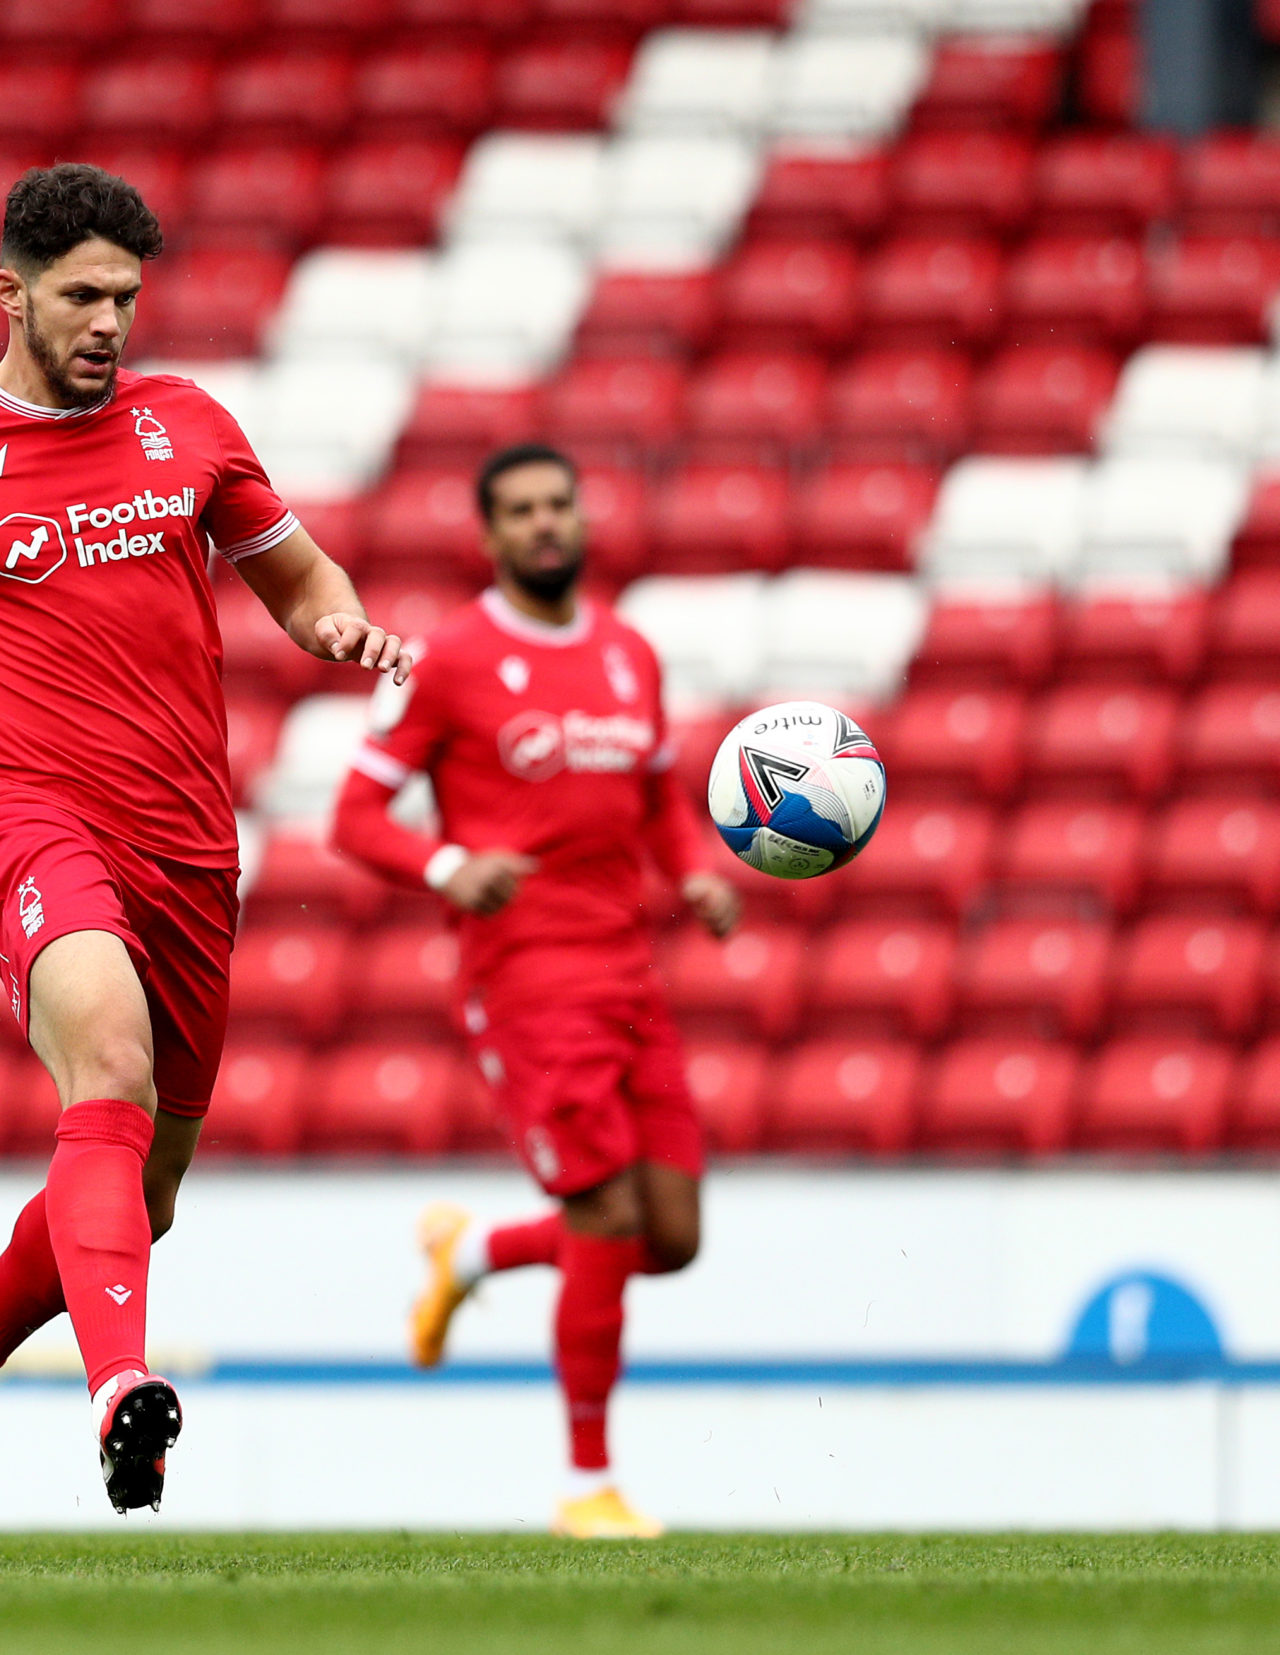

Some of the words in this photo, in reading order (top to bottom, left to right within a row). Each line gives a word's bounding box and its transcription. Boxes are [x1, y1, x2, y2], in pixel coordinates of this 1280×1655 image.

[66, 486, 195, 534] Football
[73, 528, 166, 568] Index
[754, 716, 822, 735] mitre
